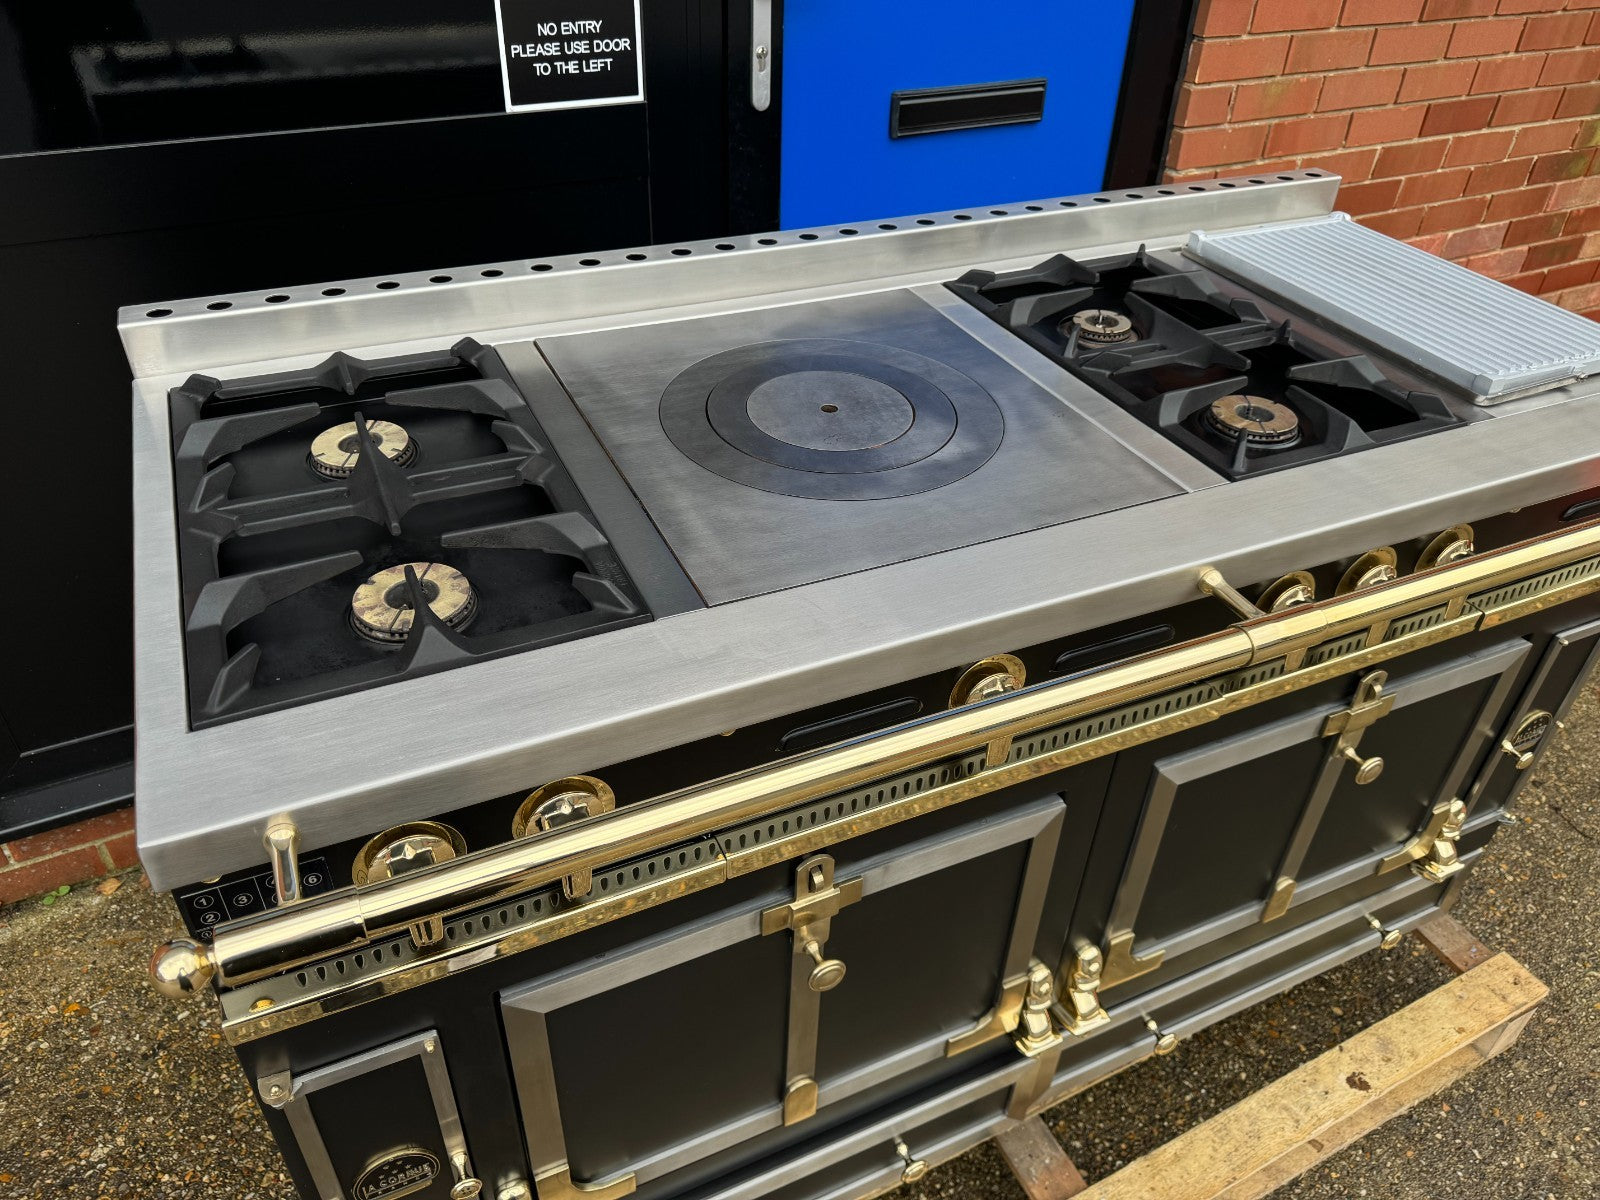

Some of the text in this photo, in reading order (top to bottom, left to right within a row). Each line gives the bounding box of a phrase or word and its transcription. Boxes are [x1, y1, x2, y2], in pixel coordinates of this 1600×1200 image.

[537, 20, 603, 37] NO ENTRY
[510, 38, 631, 58] PLEASE USE DOOR
[533, 58, 613, 77] TO THE LEFT
